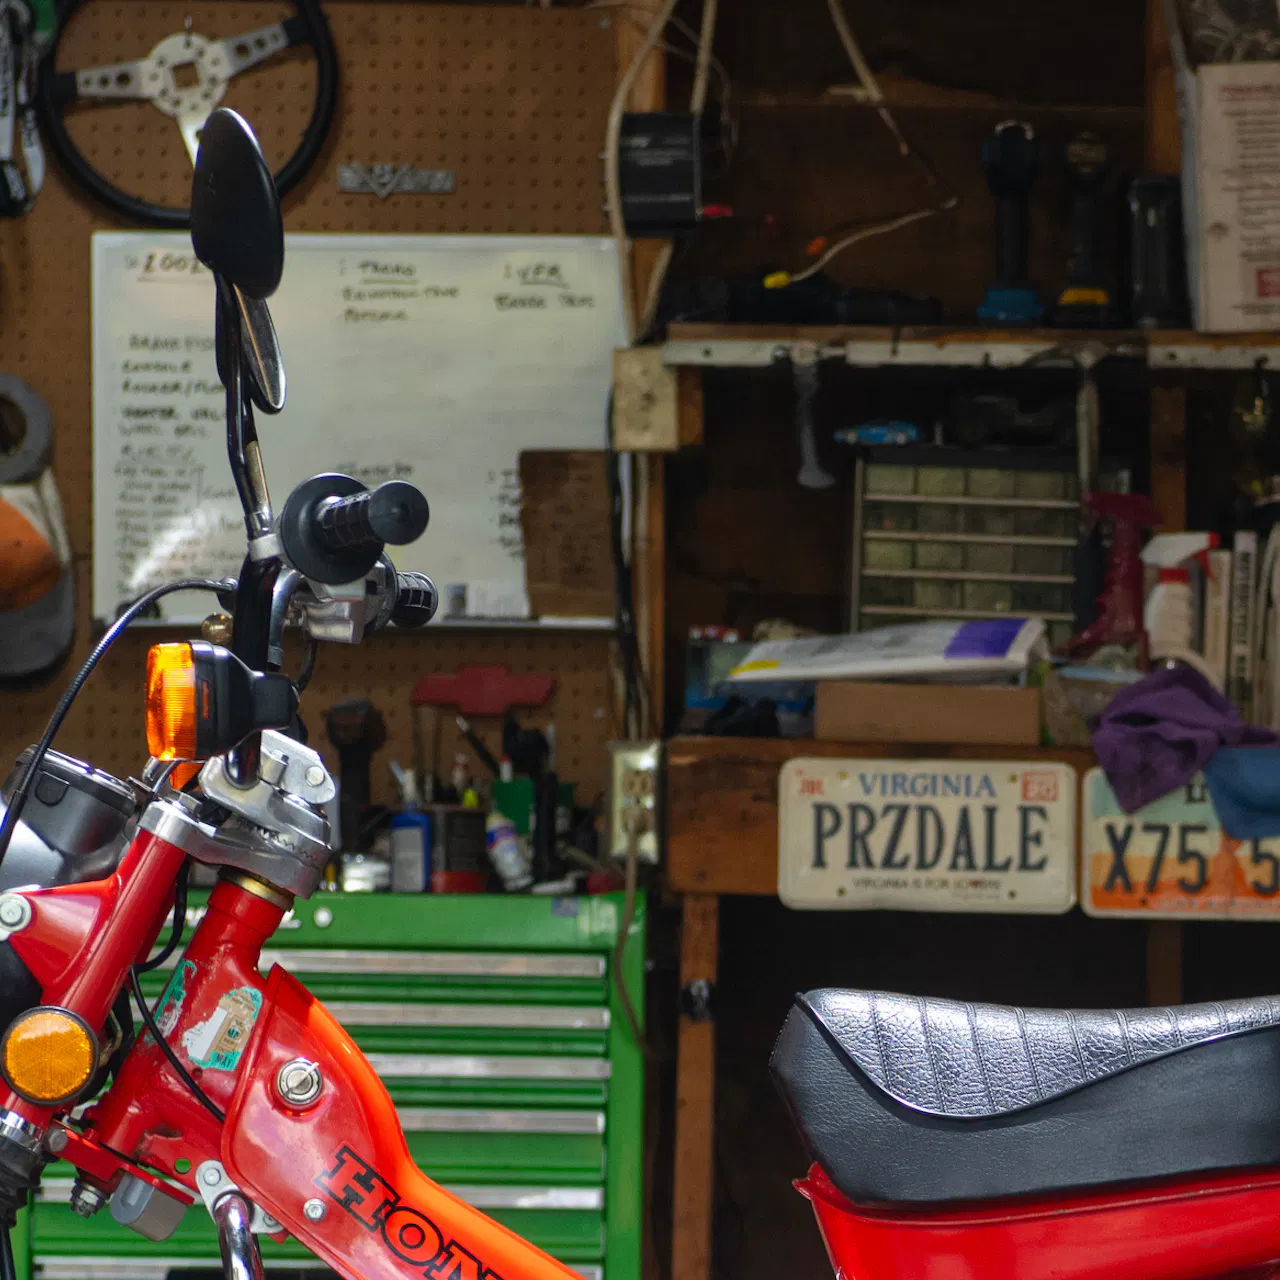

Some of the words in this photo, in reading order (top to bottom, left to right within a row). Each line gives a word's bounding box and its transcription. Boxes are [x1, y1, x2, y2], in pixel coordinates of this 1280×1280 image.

[858, 772, 997, 799] VIRGINIA
[810, 801, 1049, 873] PRZDALE
[1103, 823, 1209, 895] X75
